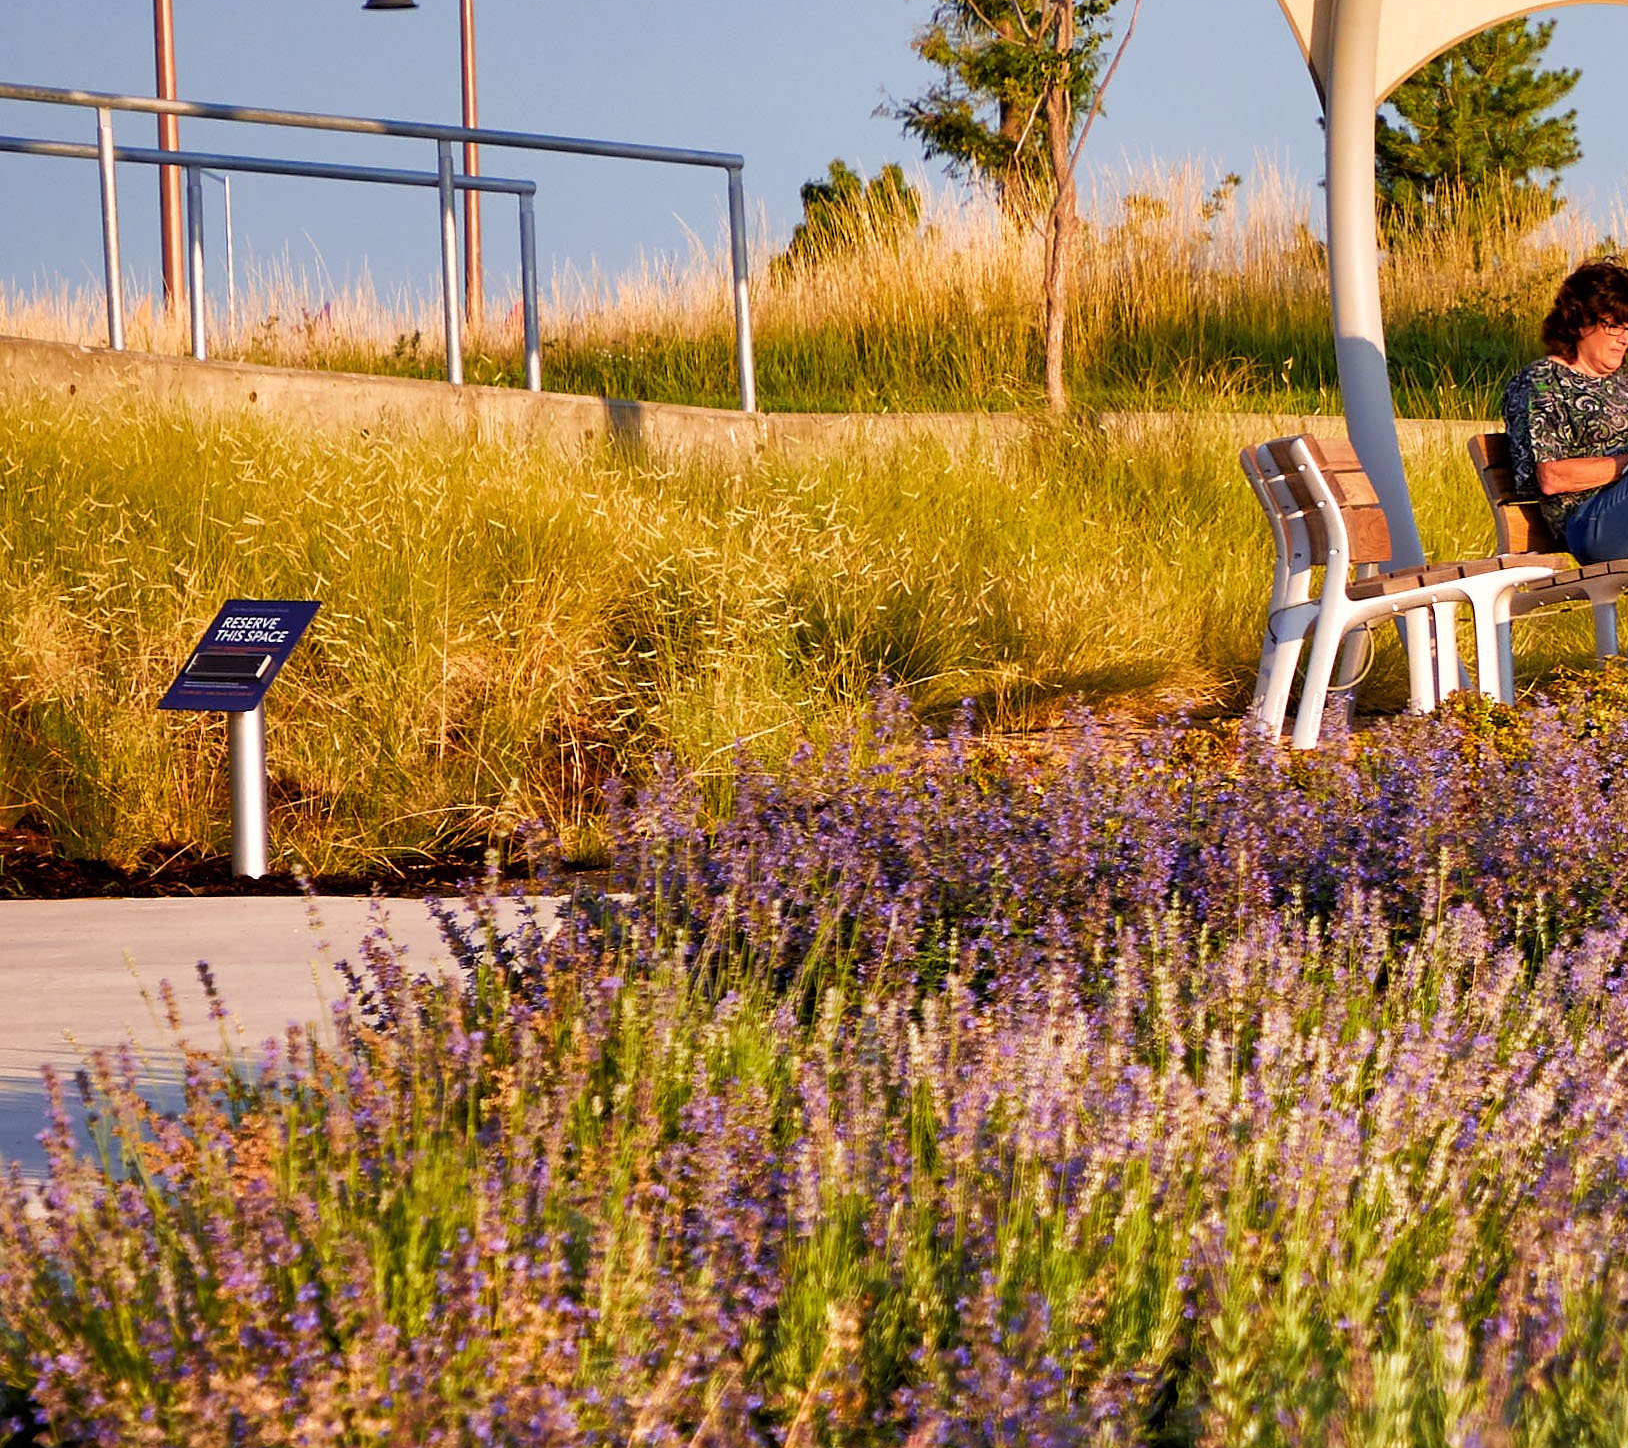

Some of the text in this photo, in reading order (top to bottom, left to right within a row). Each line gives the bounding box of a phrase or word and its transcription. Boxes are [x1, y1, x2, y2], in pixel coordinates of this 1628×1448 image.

[221, 617, 281, 629] RESERVE
[214, 630, 289, 643] THIS SPACE
